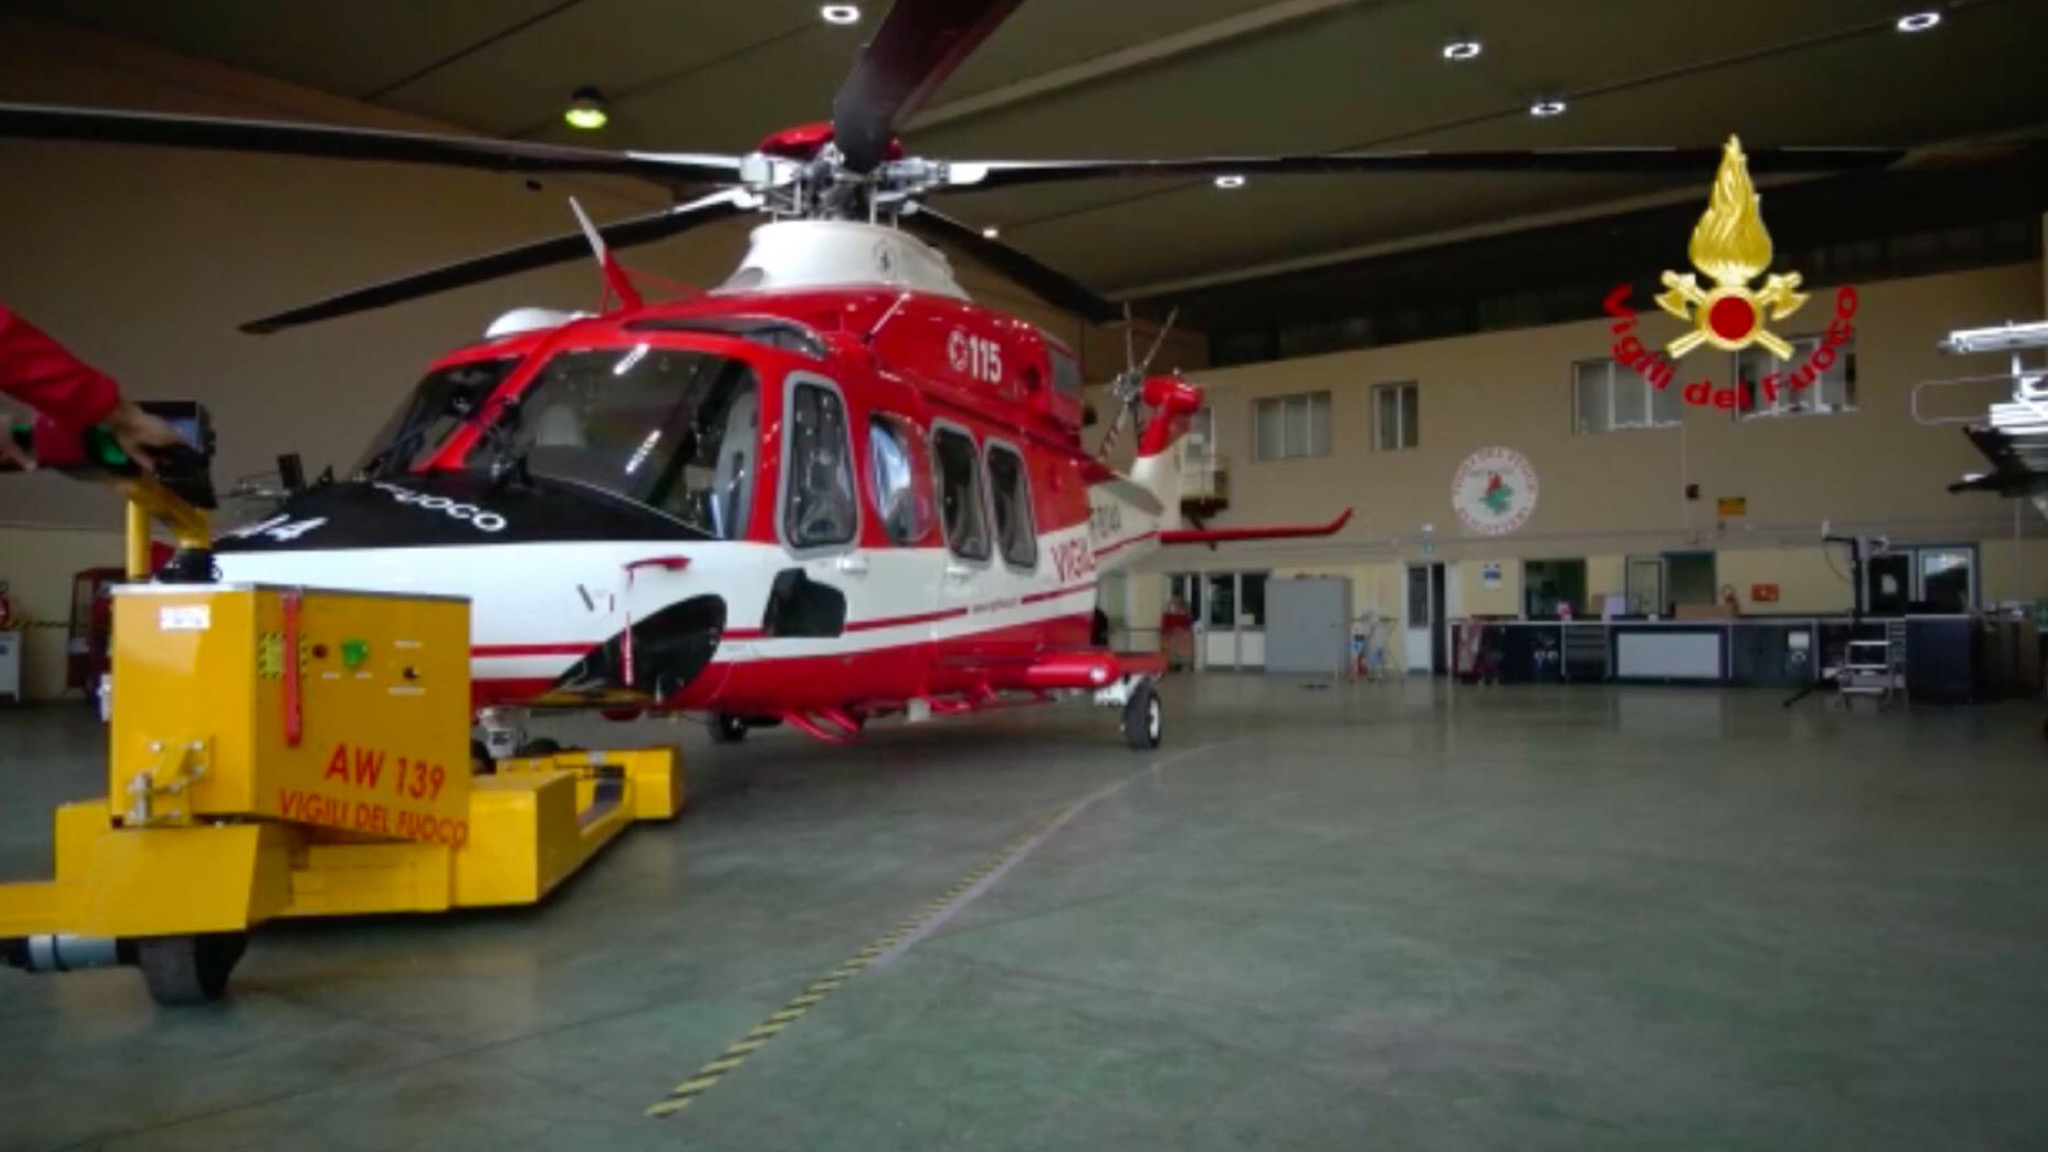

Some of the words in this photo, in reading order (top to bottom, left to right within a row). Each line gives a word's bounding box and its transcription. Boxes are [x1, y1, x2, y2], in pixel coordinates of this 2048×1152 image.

[969, 333, 1002, 385] 115
[325, 743, 385, 791] AW
[395, 756, 446, 802] 139
[279, 789, 349, 827] VIGILI
[354, 802, 389, 834] DEL
[396, 810, 469, 847] FUOCO
